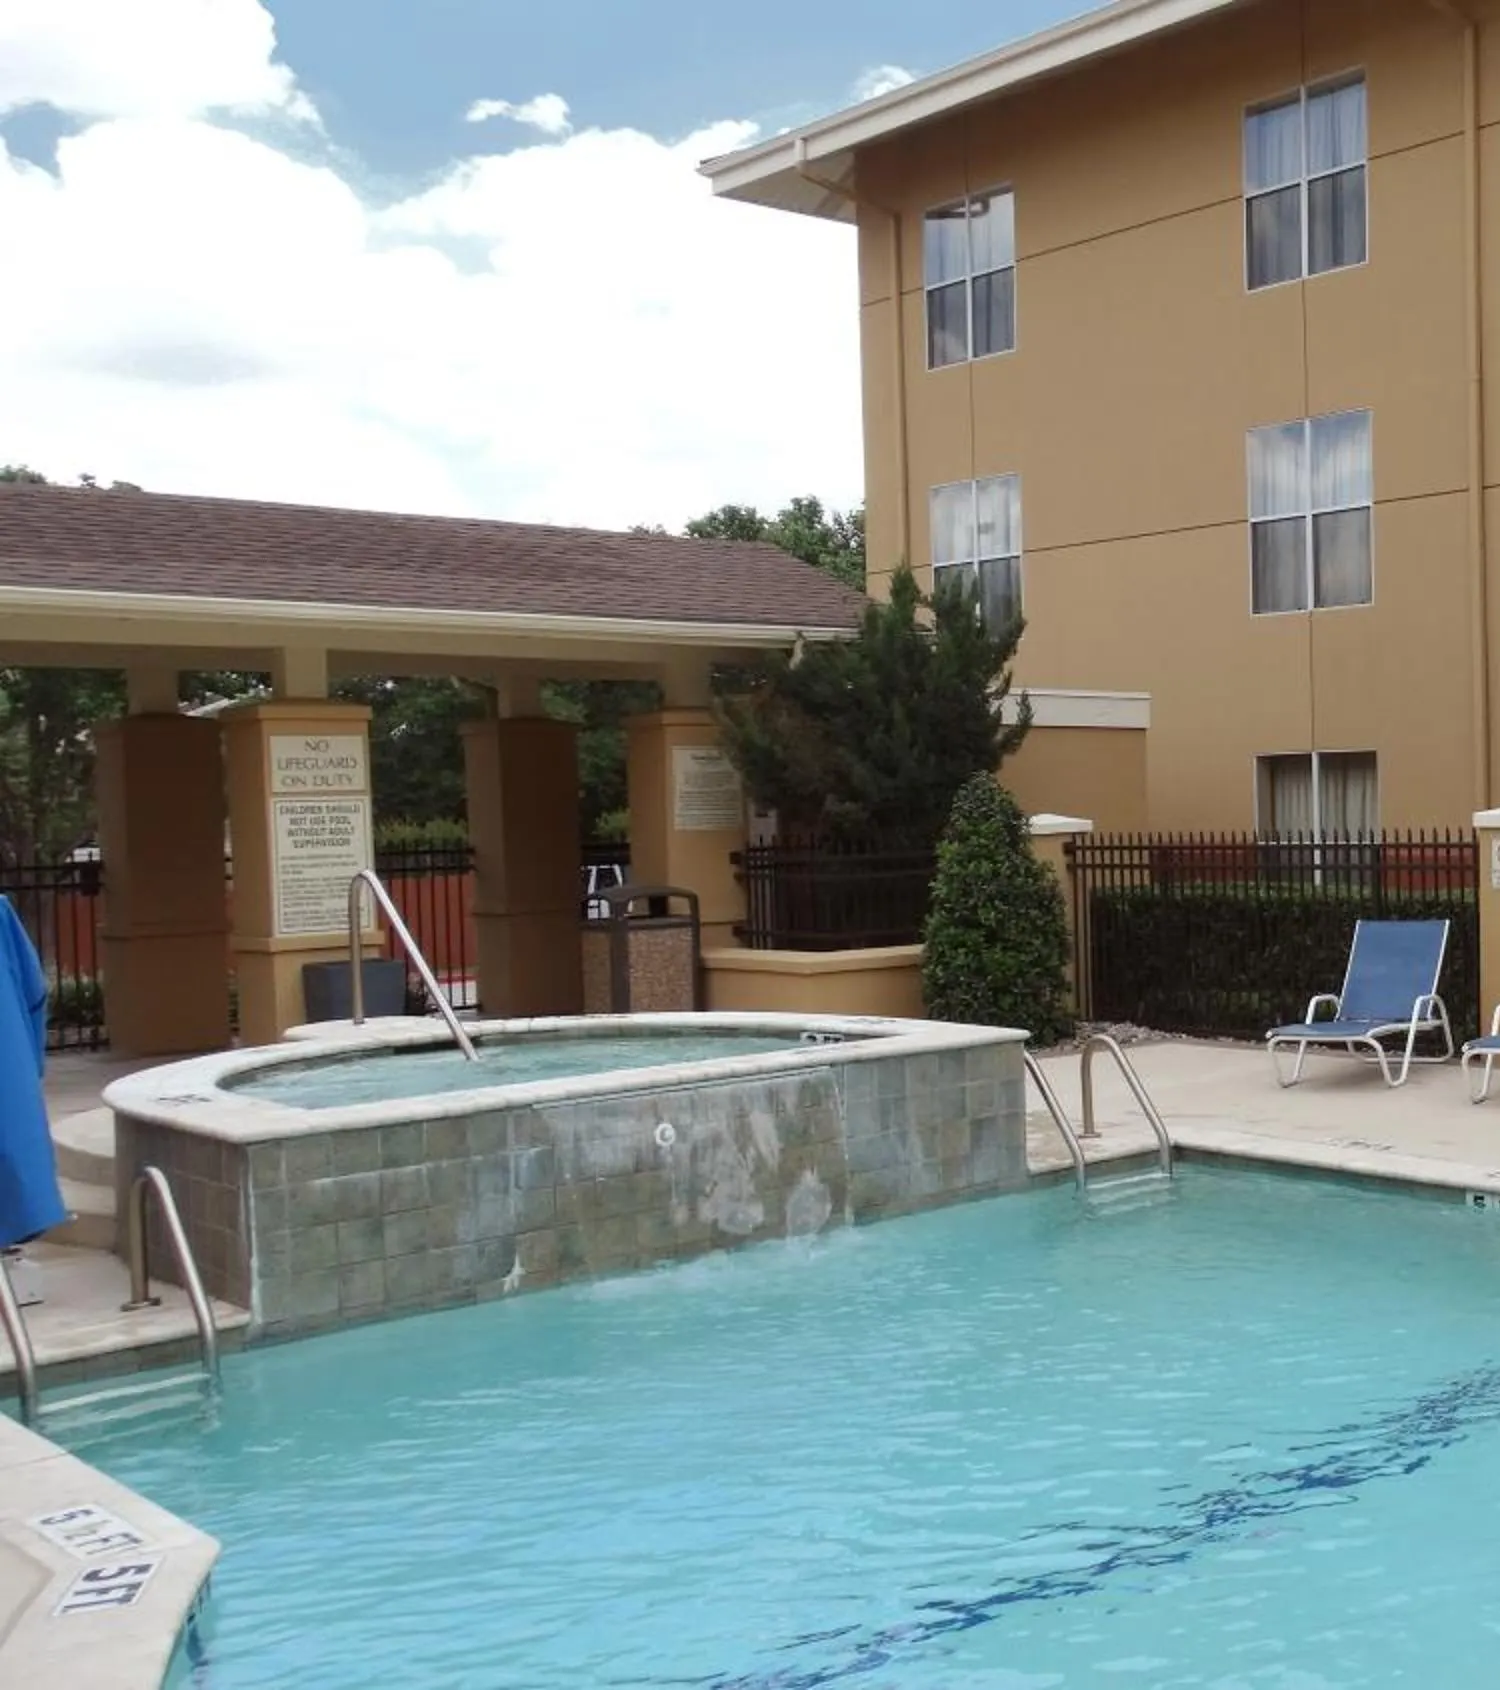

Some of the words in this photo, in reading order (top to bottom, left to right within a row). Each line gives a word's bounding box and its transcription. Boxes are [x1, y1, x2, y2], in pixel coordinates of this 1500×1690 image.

[304, 739, 330, 752] NO
[277, 757, 357, 770] LIFEGUARD
[282, 775, 307, 787] ON
[313, 773, 353, 787] DUTY
[81, 1563, 154, 1583] 5
[61, 1580, 145, 1613] FT
